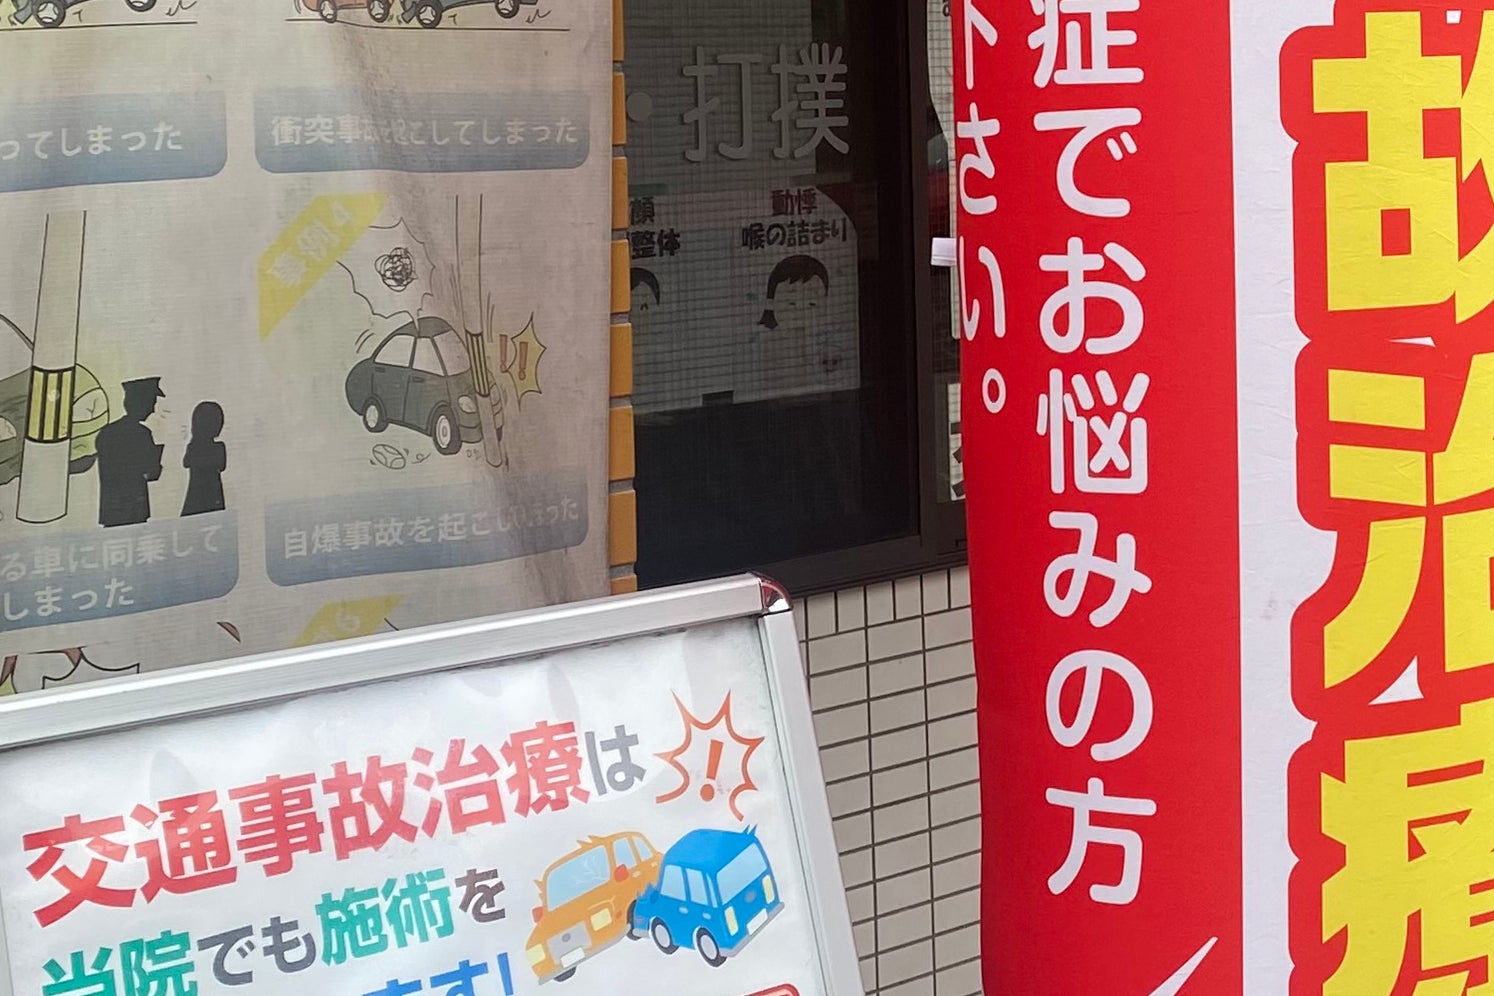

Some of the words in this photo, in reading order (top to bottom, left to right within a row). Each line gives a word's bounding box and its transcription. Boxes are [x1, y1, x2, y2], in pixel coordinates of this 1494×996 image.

[627, 228, 681, 259] 整体
[741, 217, 848, 250] 喉の詰まり
[1026, 0, 1157, 905] 症でお悩みの方
[3, 577, 135, 621] しまった
